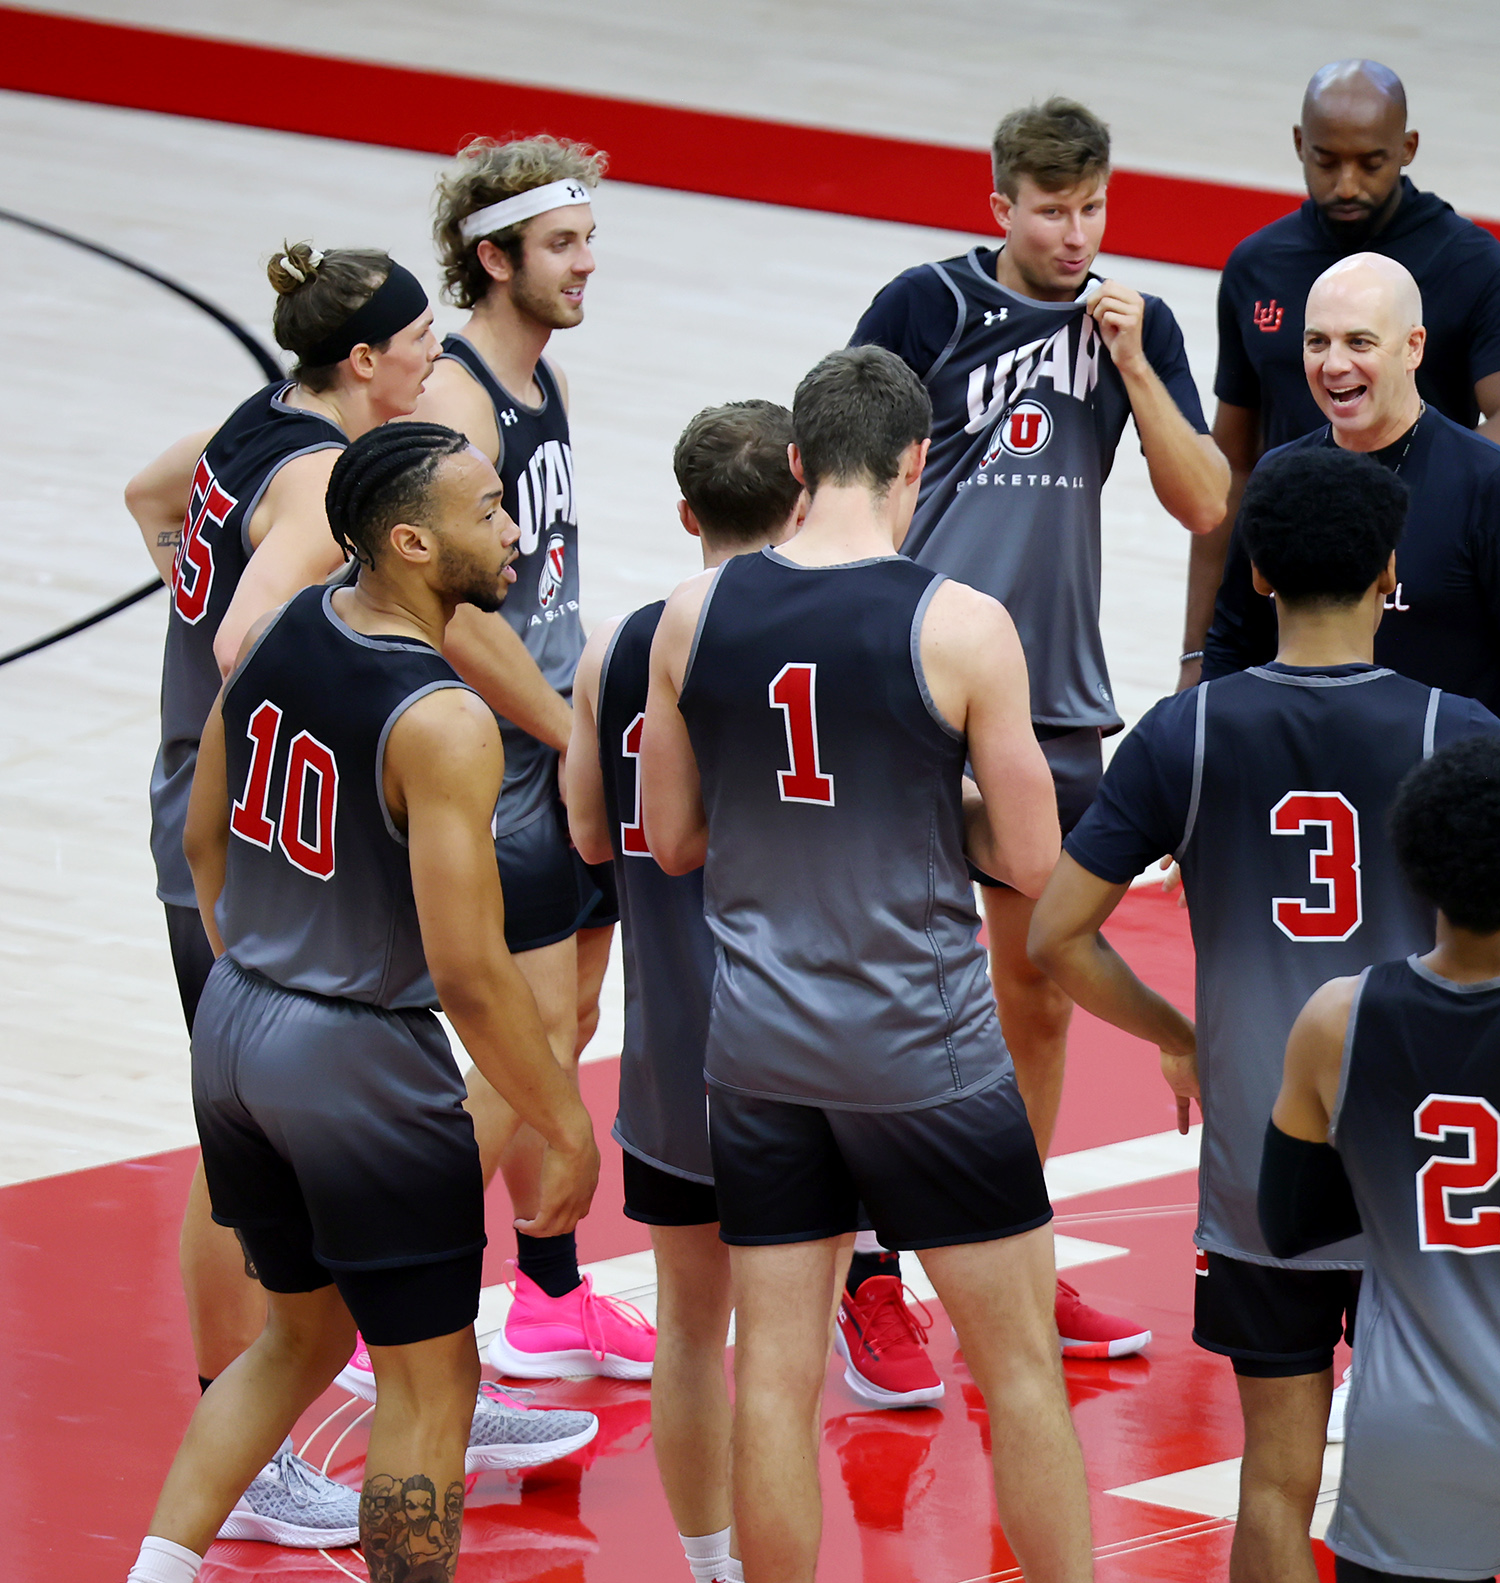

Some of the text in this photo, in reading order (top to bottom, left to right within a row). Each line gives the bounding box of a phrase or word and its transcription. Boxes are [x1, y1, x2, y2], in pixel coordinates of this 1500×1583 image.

[1010, 413, 1042, 448] U
[230, 699, 340, 881] 10
[769, 662, 834, 806] 1
[1270, 791, 1362, 942] 3
